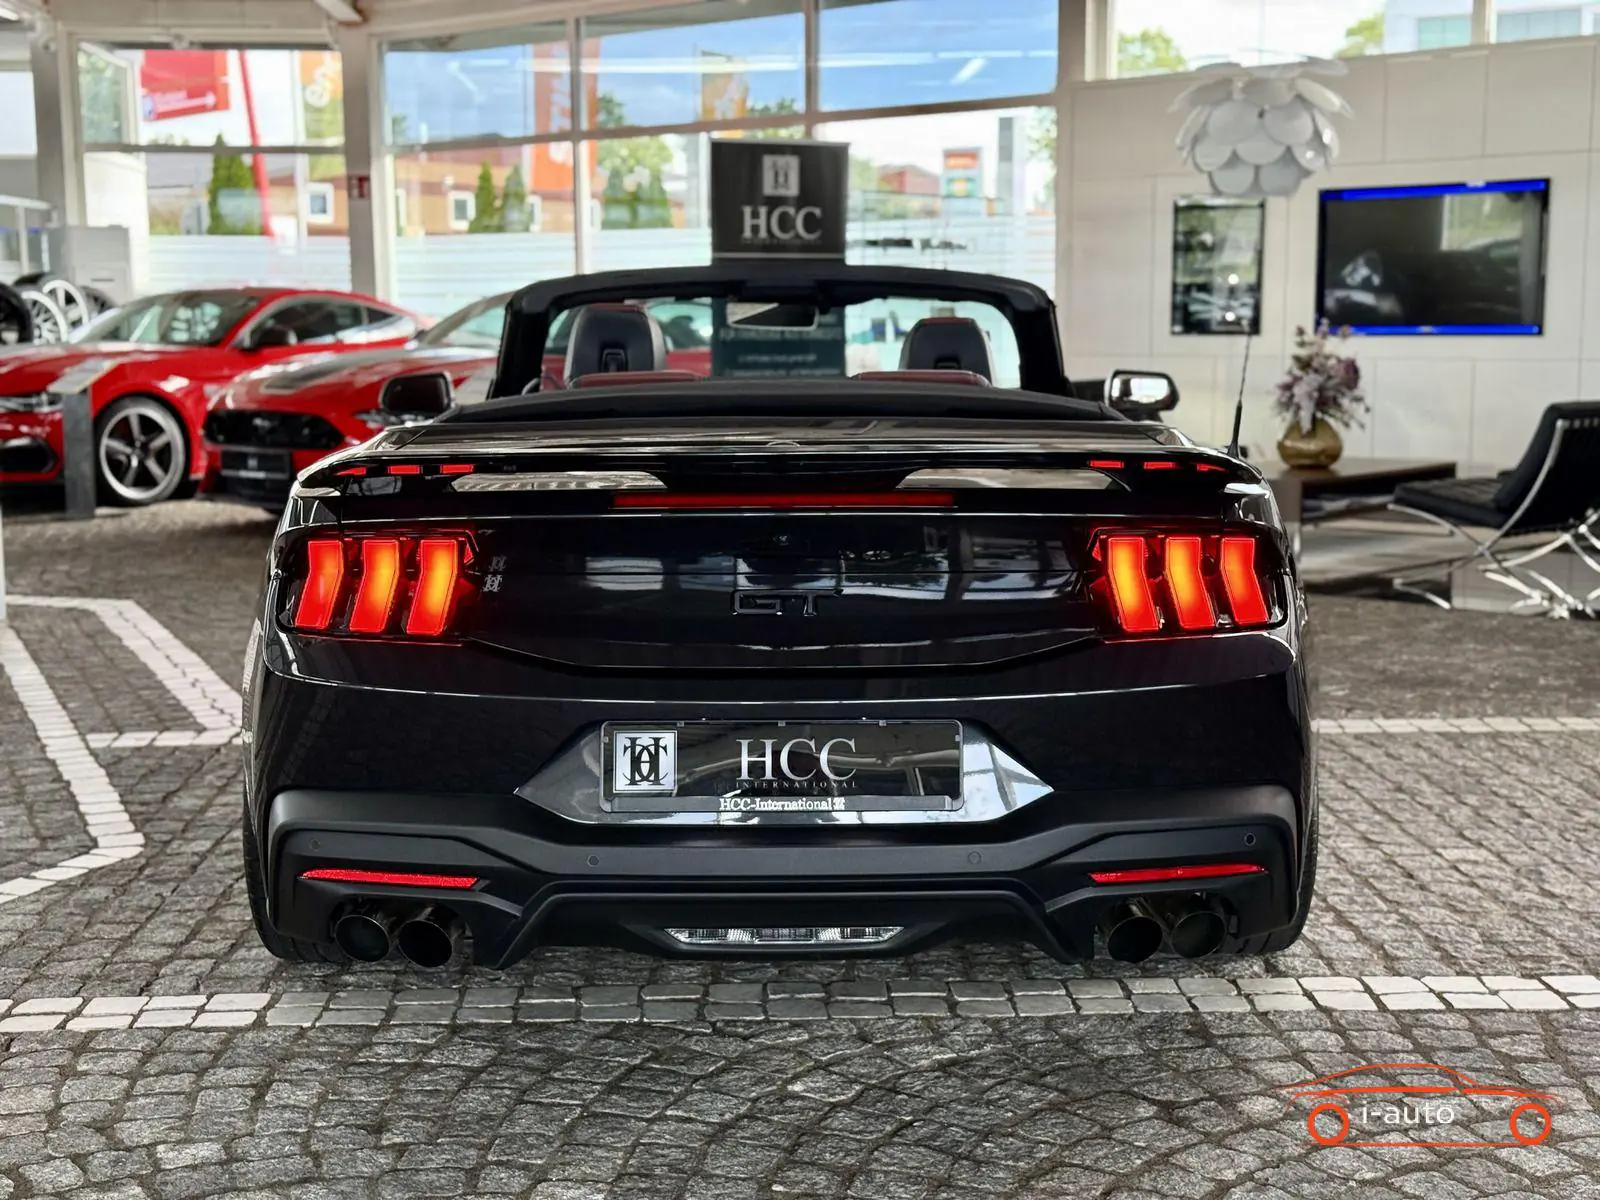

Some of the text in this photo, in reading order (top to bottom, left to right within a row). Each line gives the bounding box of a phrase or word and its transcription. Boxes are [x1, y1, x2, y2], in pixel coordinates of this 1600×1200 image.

[741, 205, 822, 240] HCC
[732, 588, 839, 616] GT
[735, 738, 857, 781] HCC
[719, 797, 832, 811] HCC-International
